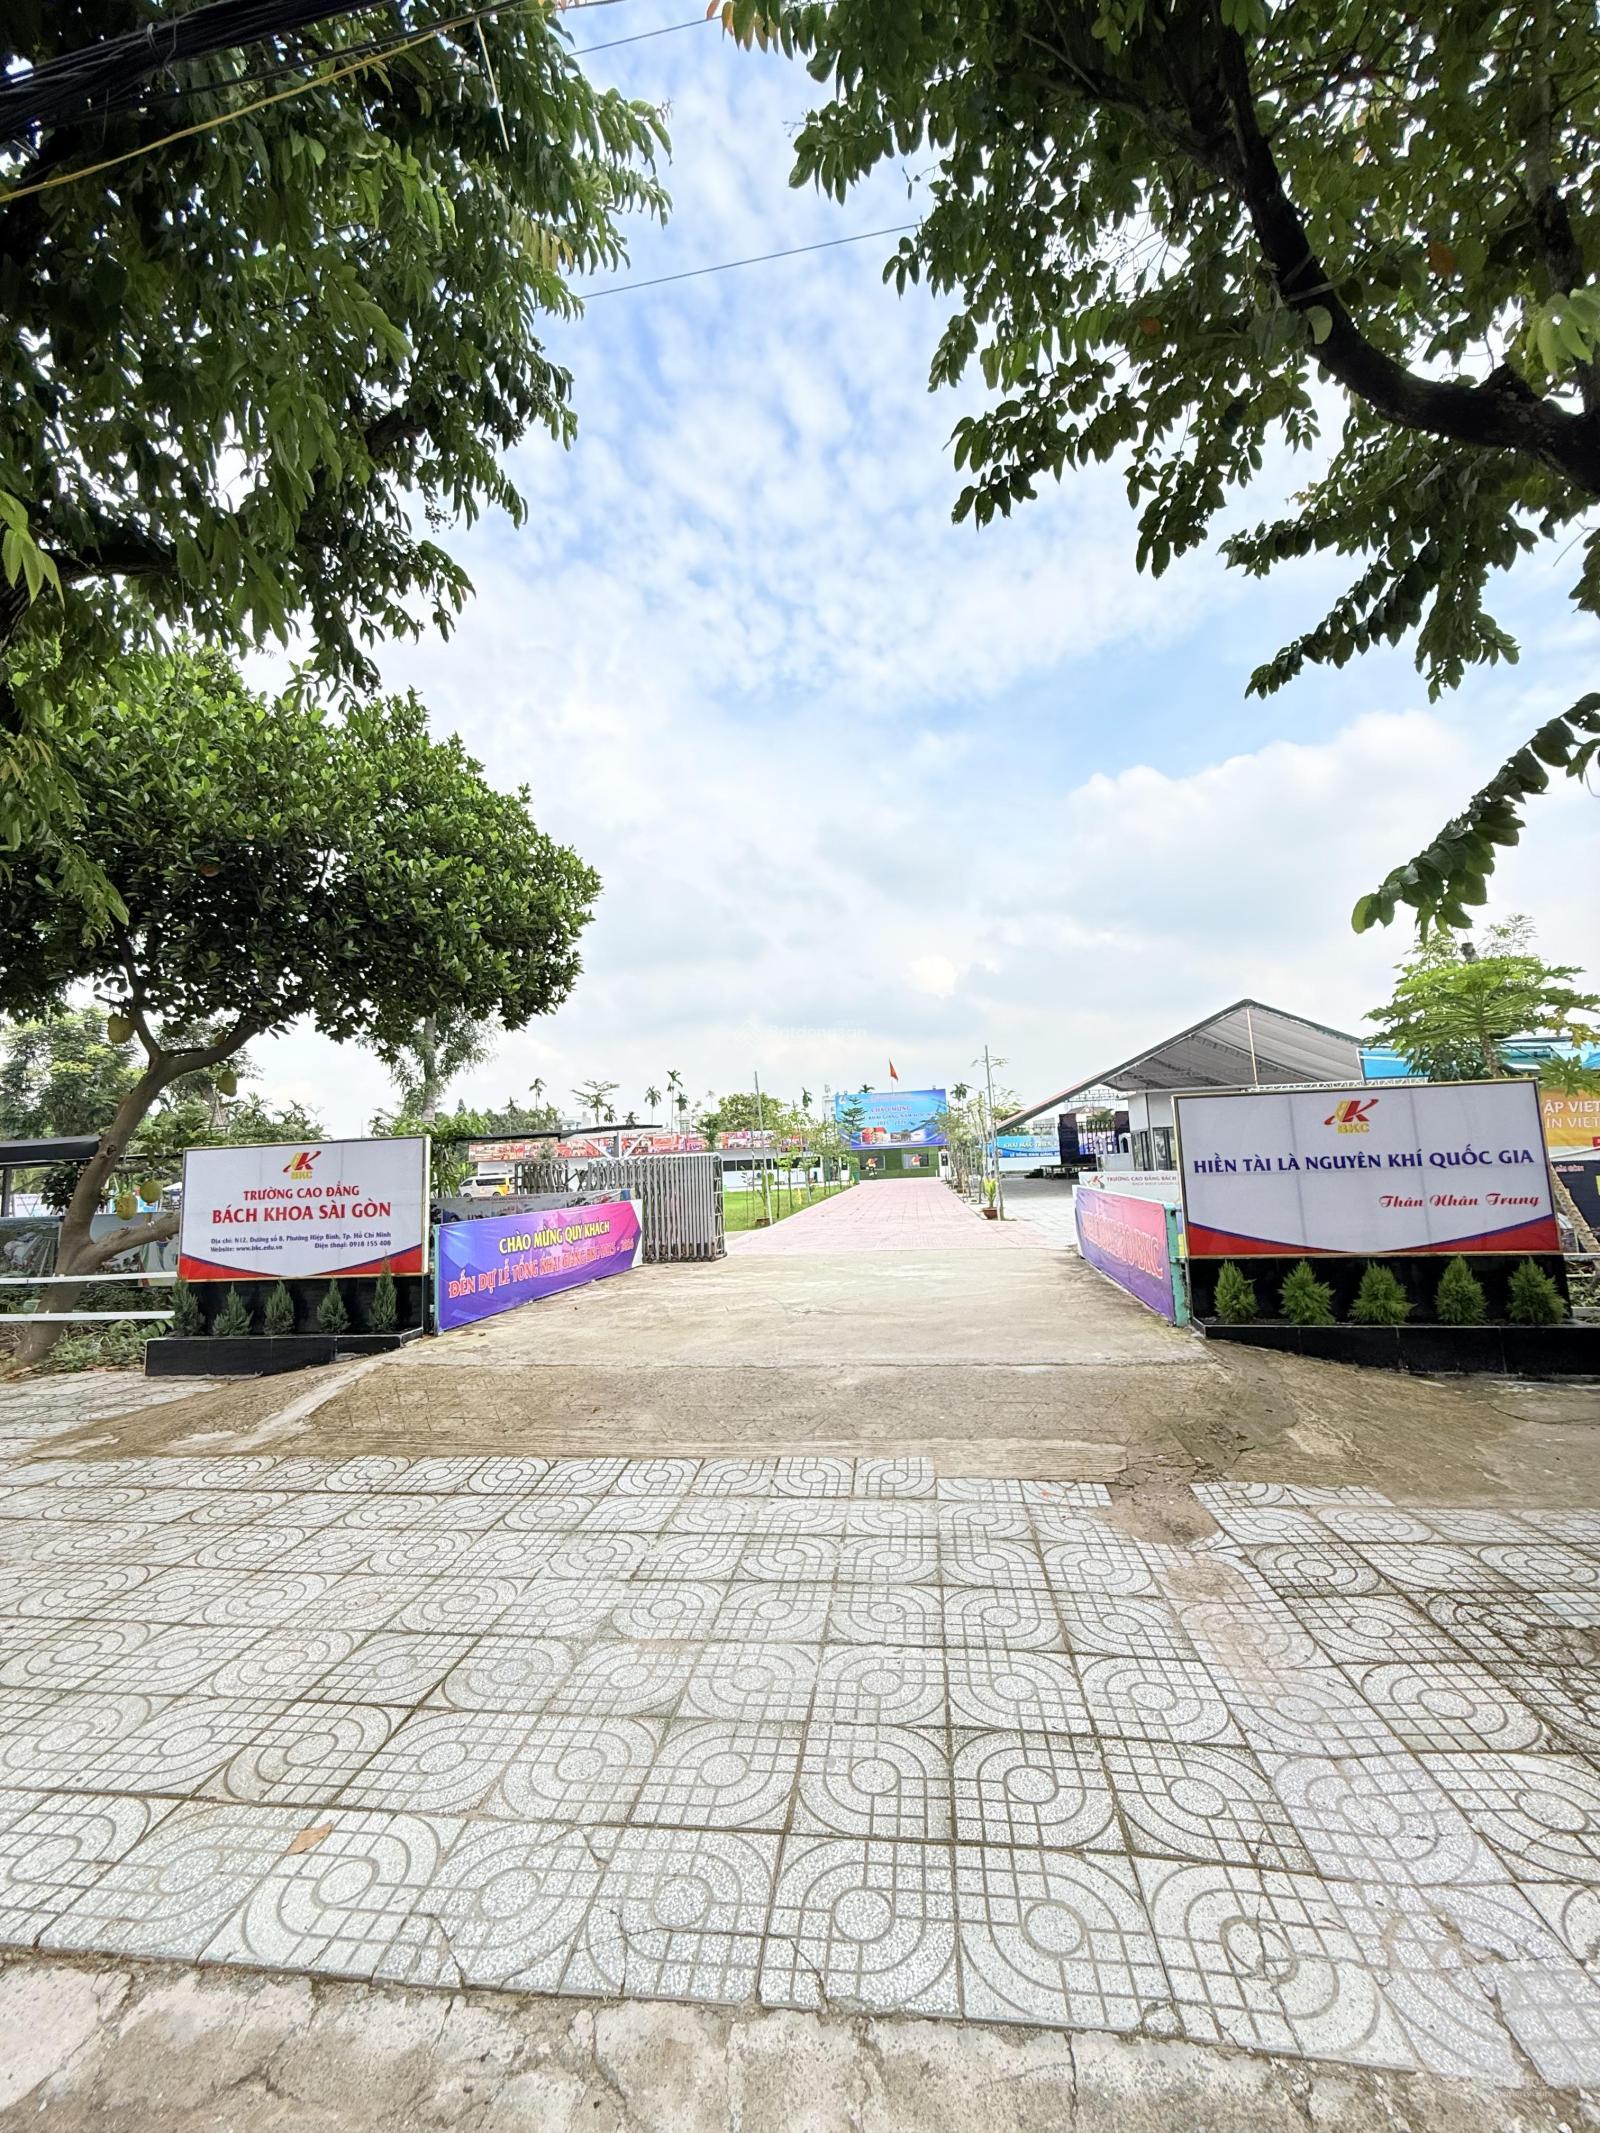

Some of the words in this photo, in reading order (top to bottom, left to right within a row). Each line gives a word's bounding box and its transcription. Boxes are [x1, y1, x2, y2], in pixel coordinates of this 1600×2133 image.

[1338, 1123, 1370, 1134] BKC
[1547, 1118, 1562, 1128] IN
[1194, 1152, 1236, 1173] HIỀN
[1242, 1154, 1271, 1172] TÀI
[1278, 1153, 1300, 1171] LÀ
[1305, 1151, 1381, 1170] NGUYÊN
[1388, 1148, 1422, 1168] KHÍ
[1429, 1143, 1493, 1169] QUỐC
[1498, 1149, 1535, 1164] GIA
[243, 1186, 293, 1200] TRƯỜNG
[297, 1187, 322, 1199] CAO
[326, 1180, 359, 1197] ĐẲNG
[212, 1204, 257, 1224] BÁCH
[264, 1205, 314, 1221] KHOA
[319, 1199, 345, 1219] SÀI
[352, 1197, 391, 1218] GÒN
[1379, 1195, 1424, 1208] Thân
[1429, 1194, 1478, 1207] Nhân
[1485, 1193, 1539, 1208] Trung
[376, 1230, 391, 1238] Minh
[499, 1230, 531, 1255] CHÀO
[534, 1224, 563, 1249] MỪNG
[448, 1269, 476, 1299] ĐẾN
[478, 1268, 497, 1294] DỰ
[498, 1258, 510, 1286] LỄ
